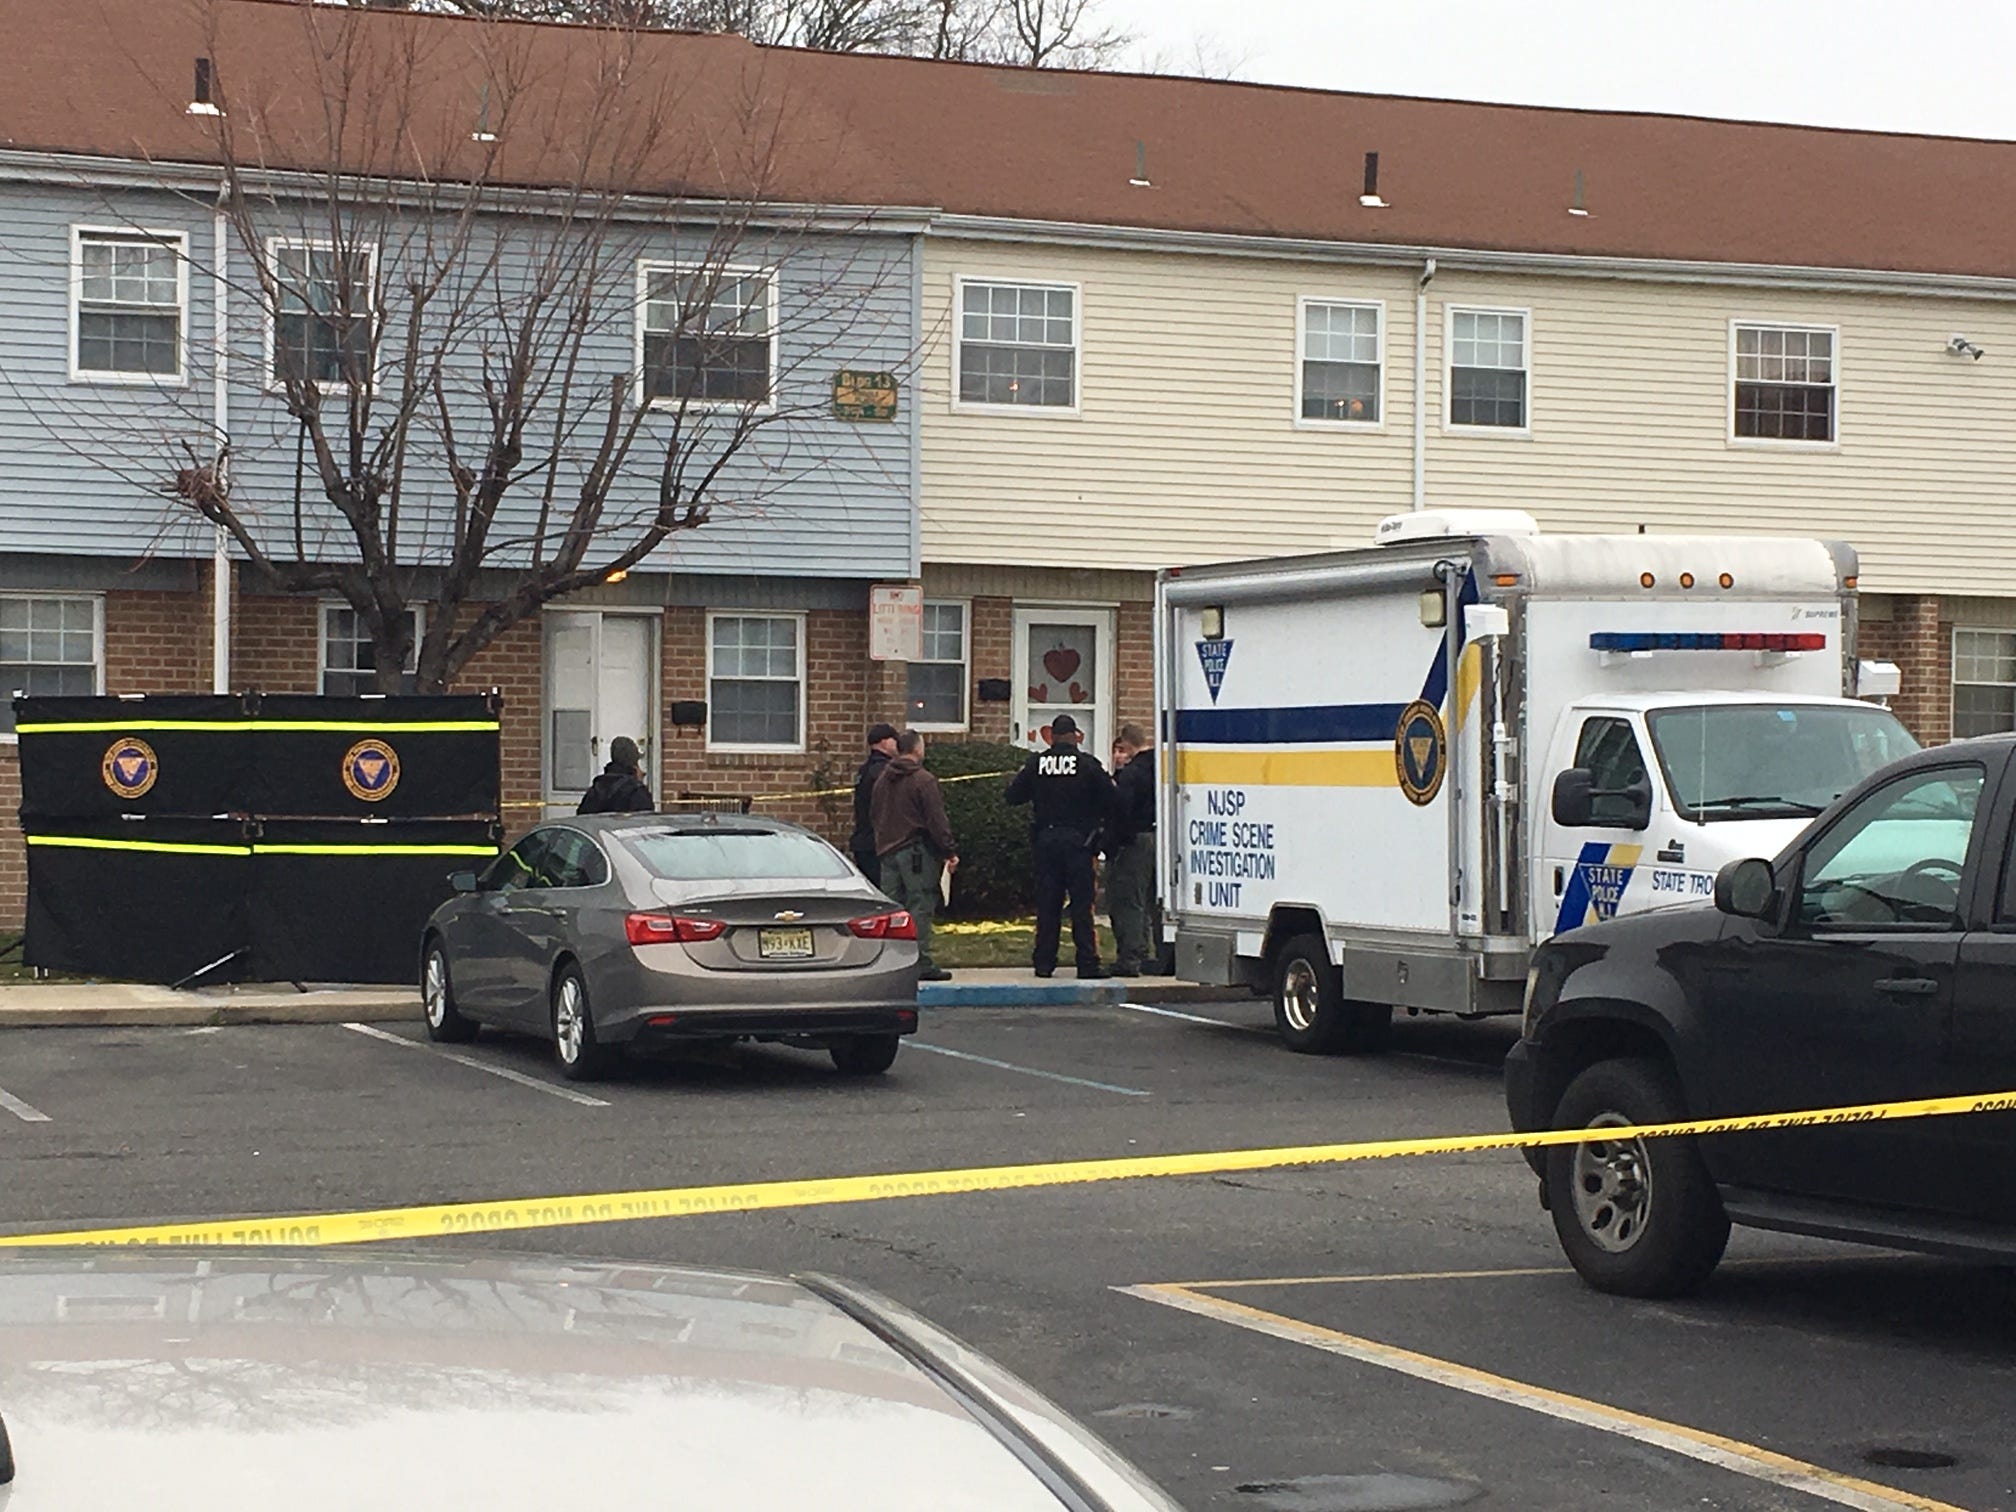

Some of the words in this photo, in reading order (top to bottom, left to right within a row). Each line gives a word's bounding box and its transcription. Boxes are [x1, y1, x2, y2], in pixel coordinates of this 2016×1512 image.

[1202, 643, 1227, 657] STATE
[1204, 658, 1224, 672] POLICE
[1038, 755, 1077, 775] POLICE
[1208, 790, 1246, 816] NJSP
[1189, 819, 1227, 846] CRIME
[1232, 822, 1274, 849] SCENE
[1190, 850, 1275, 880] INVESTIGATION
[1588, 868, 1623, 885] STATE
[1652, 870, 1685, 892] STATE
[1208, 881, 1242, 908] UNIT
[1591, 885, 1619, 902] POLICE
